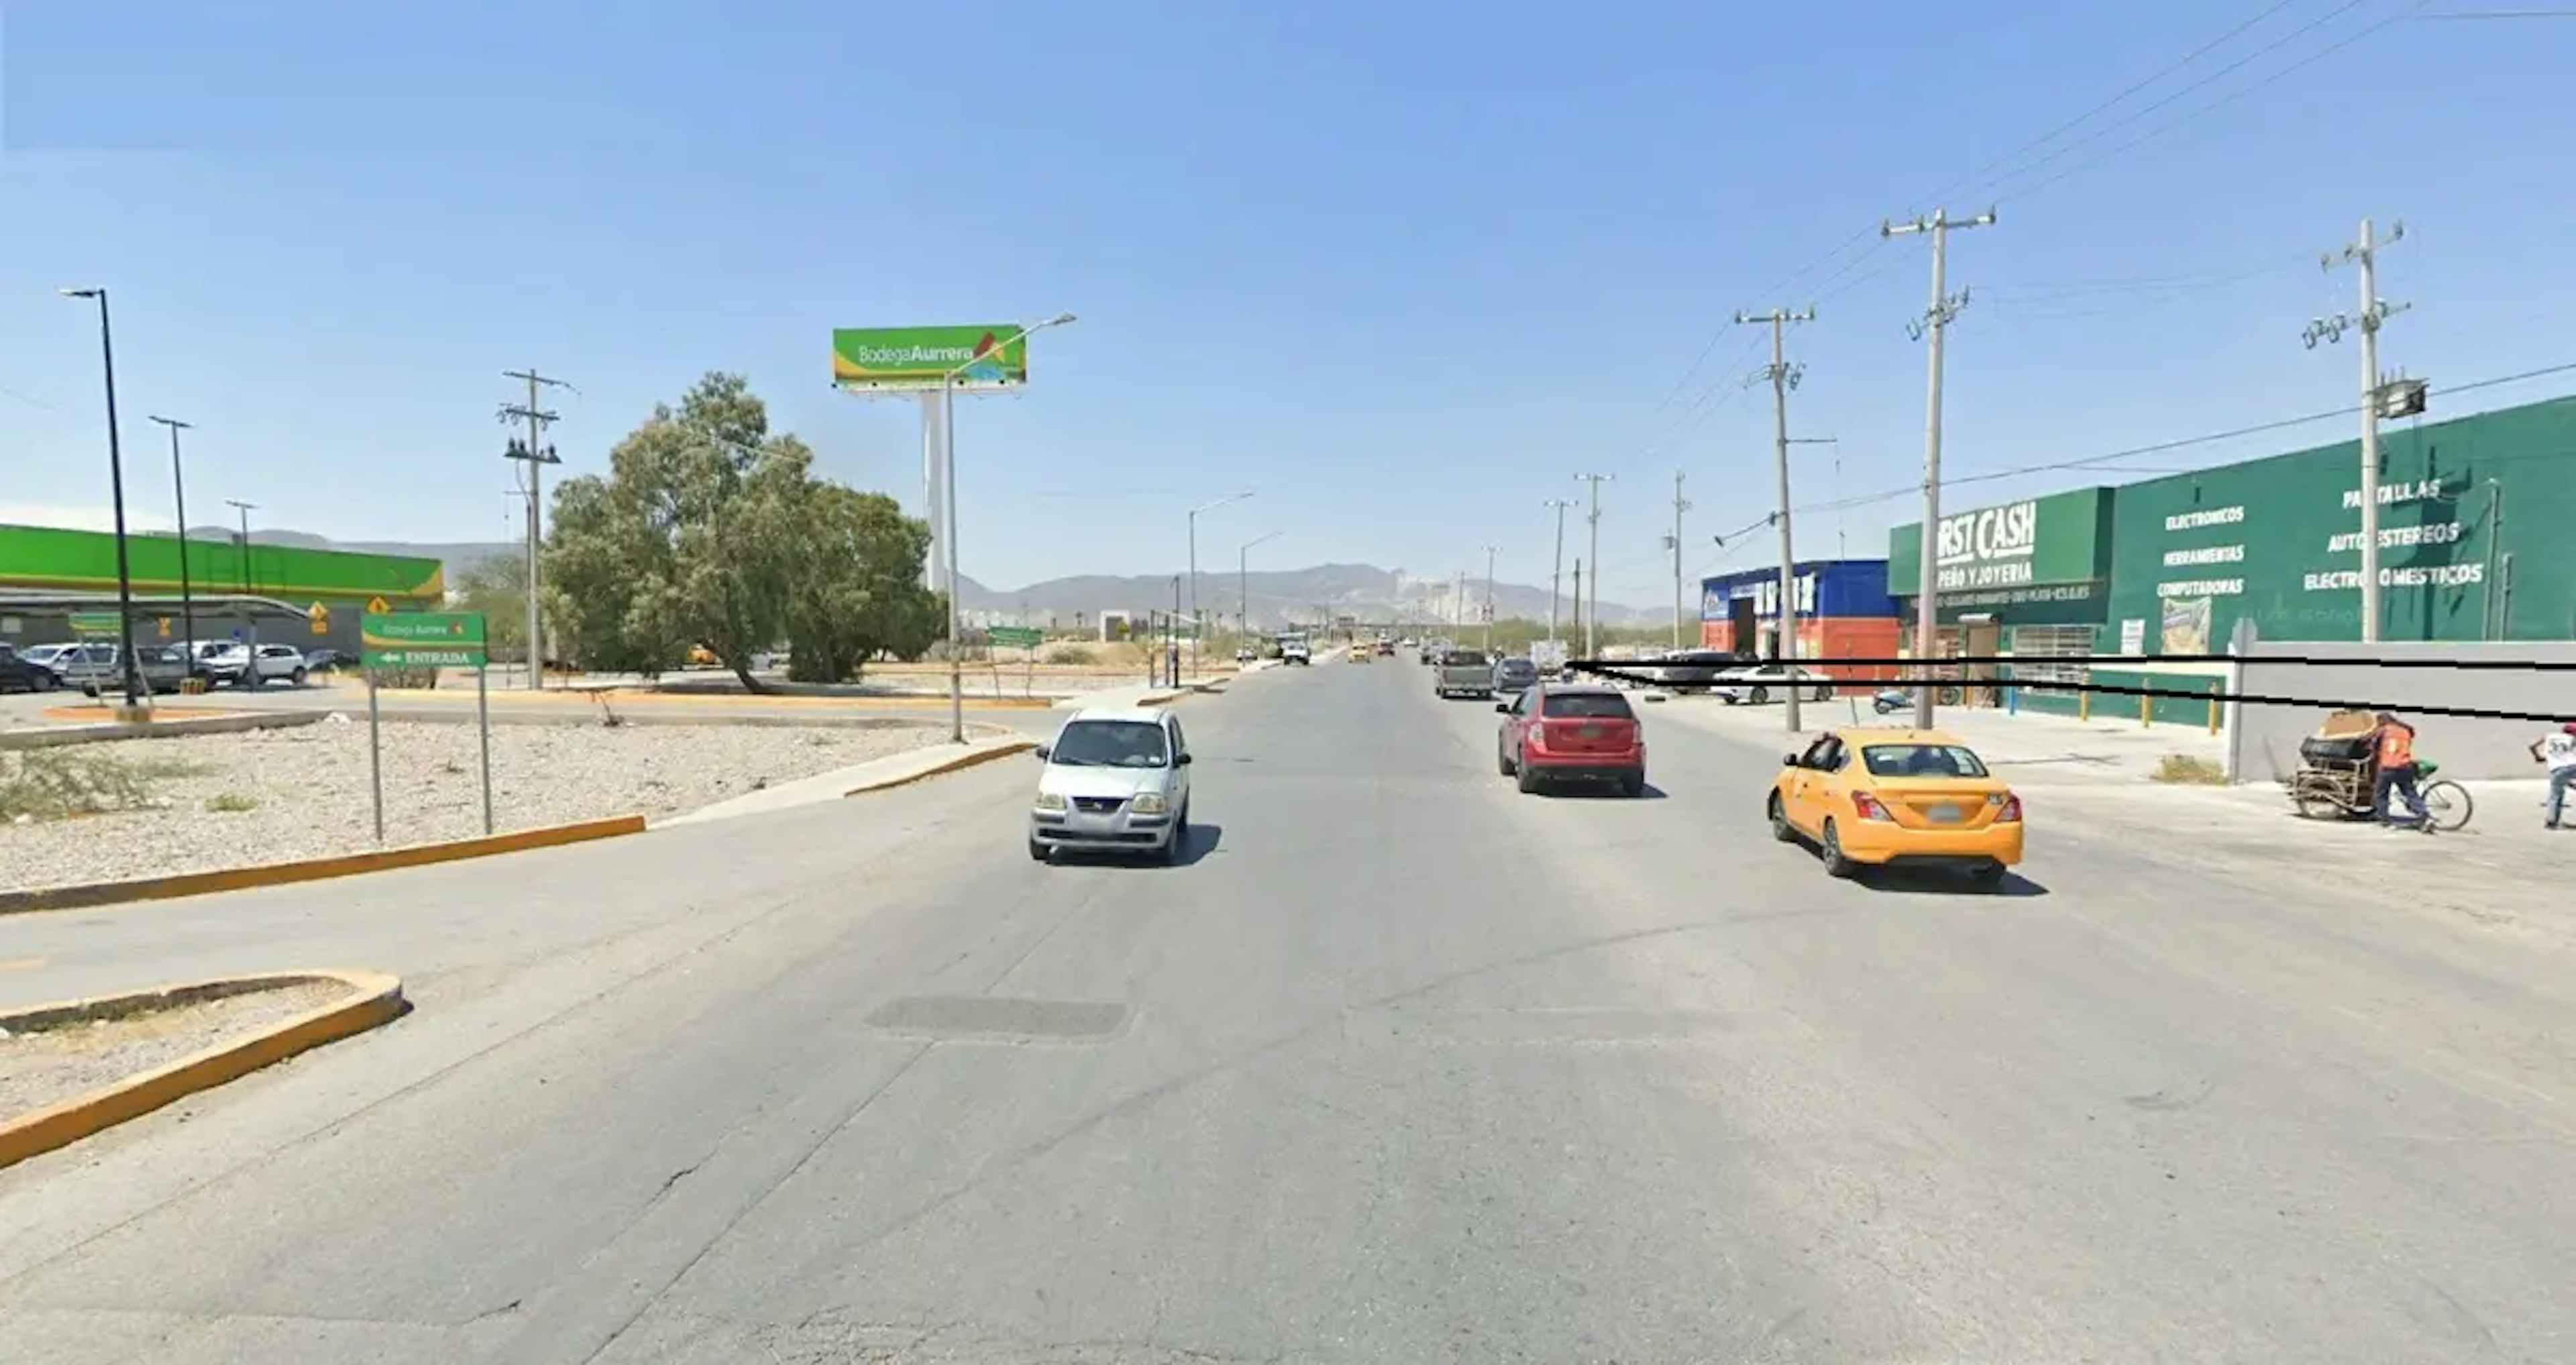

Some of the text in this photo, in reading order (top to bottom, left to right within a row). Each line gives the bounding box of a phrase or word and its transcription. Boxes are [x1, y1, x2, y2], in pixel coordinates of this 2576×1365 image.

[2343, 479, 2442, 509] PATALLAS
[1976, 501, 2037, 559] CASH
[2164, 505, 2245, 531] ELECTRONICOS
[2163, 544, 2245, 567] HERRAMIENTAS
[2157, 578, 2245, 598] COMPUTADORAS
[405, 651, 470, 664] ENTRADA
